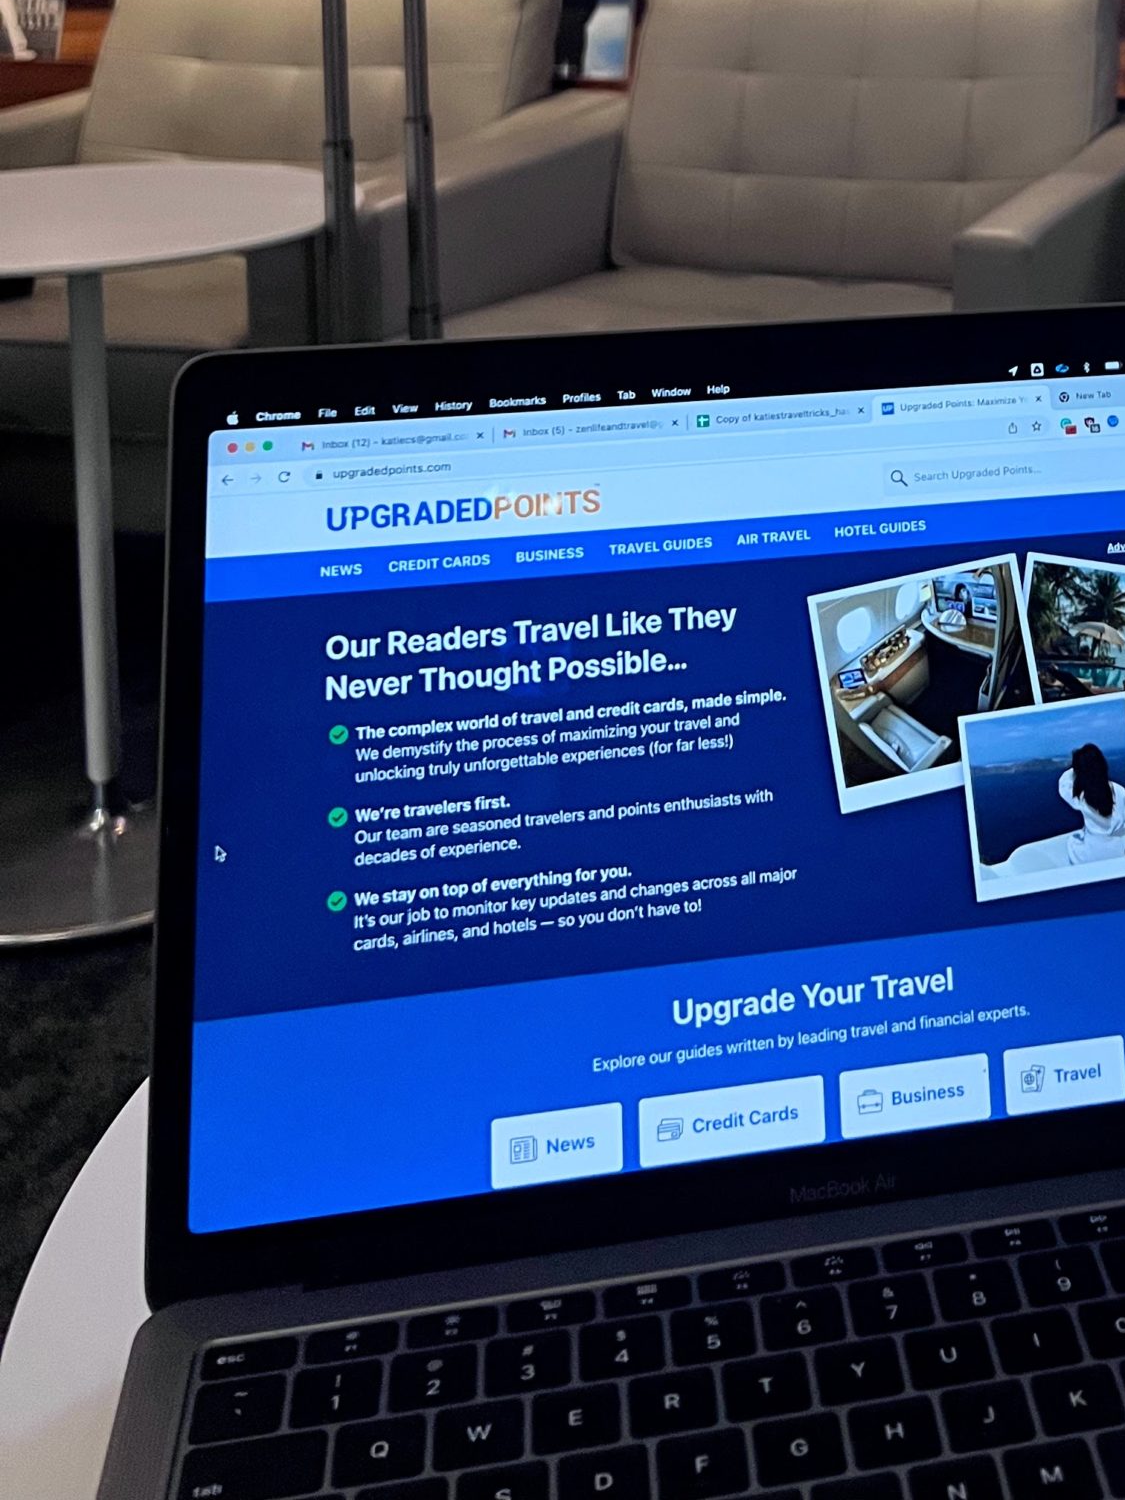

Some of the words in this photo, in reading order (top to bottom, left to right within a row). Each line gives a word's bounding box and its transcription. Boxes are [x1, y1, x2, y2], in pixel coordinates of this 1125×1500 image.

[254, 410, 302, 423] Chrome
[317, 407, 338, 419] File
[353, 404, 376, 417] Edit
[391, 403, 419, 414] View
[434, 400, 473, 412] History
[488, 394, 547, 409] Bookmarks
[561, 391, 602, 404] Profiles
[616, 389, 637, 401] Tab
[650, 386, 692, 398] Window
[705, 383, 731, 395] Help
[331, 462, 452, 481] upgradedpoints.com
[912, 469, 949, 483] Search
[950, 466, 1001, 481] Upgraded
[1001, 464, 1043, 477] Points...
[735, 532, 759, 546] AIR
[760, 528, 812, 544] TRAVEL
[833, 523, 877, 538] HOTEL
[878, 518, 927, 534] GUIDES
[514, 545, 585, 564] BUSINESS
[607, 540, 660, 556] TRAVEL
[661, 535, 713, 552] GUIDES
[319, 562, 363, 578] NEWS
[387, 556, 440, 573] CREDIT
[441, 553, 491, 569] CARDS
[324, 634, 382, 661] Our
[386, 624, 507, 656] Readers
[512, 613, 599, 645] Travel
[605, 609, 663, 638] Like
[667, 605, 738, 633] They
[324, 673, 413, 701] Never
[417, 659, 542, 693] Thought
[547, 647, 688, 682] Possible...
[354, 724, 386, 741] The
[387, 718, 454, 738] complex
[455, 713, 500, 731] world
[500, 710, 519, 728] of
[519, 707, 564, 726] travel
[565, 704, 595, 722] and
[595, 700, 641, 719] credit
[642, 696, 689, 714] cards,
[690, 692, 733, 710] made
[734, 687, 787, 707] simple.
[354, 746, 380, 762] We
[381, 739, 453, 760] demystify
[454, 737, 480, 753] the
[481, 733, 539, 753] process
[540, 728, 557, 745] of
[558, 722, 638, 743] maximizing
[639, 720, 672, 738] your
[673, 714, 712, 732] travel
[713, 711, 741, 729] and
[354, 763, 426, 784] unlocking
[427, 759, 461, 777] truly
[463, 750, 559, 773] unforgettable
[560, 744, 646, 765] experiences
[648, 739, 674, 758] (for
[674, 737, 696, 753] far
[696, 732, 734, 750] less!)
[353, 805, 401, 823] We're
[402, 798, 472, 818] travelers
[473, 794, 511, 811] first.
[353, 828, 383, 845] Our
[384, 826, 423, 842] team
[424, 823, 450, 838] are
[451, 812, 522, 835] seasoned
[523, 808, 586, 828] travelers
[587, 803, 615, 821] and
[617, 800, 661, 821] points
[662, 792, 742, 813] enthusiasts
[743, 787, 774, 805] with
[353, 847, 418, 867] decades
[419, 842, 437, 860] of
[437, 837, 522, 859] experience.
[353, 890, 380, 907] We
[381, 888, 417, 904] stay
[418, 885, 440, 900] on
[441, 882, 469, 899] top
[470, 877, 489, 894] of
[489, 869, 573, 892] everything
[573, 867, 598, 883] for
[598, 865, 633, 883] you.
[353, 913, 377, 929] It's
[378, 911, 405, 927] our
[405, 906, 432, 926] job
[432, 906, 450, 921] to
[451, 898, 509, 918] monitor
[510, 895, 537, 913] key
[538, 890, 598, 910] updates
[599, 883, 627, 902] and
[629, 880, 690, 899] changes
[691, 874, 738, 891] across
[739, 869, 757, 886] all
[758, 866, 798, 884] major
[352, 932, 399, 952] cards,
[401, 927, 459, 946] airlines,
[461, 920, 490, 939] and
[492, 916, 538, 936] hotels
[556, 914, 576, 928] so
[577, 911, 605, 929] you
[606, 904, 645, 923] don't
[646, 902, 681, 918] have
[682, 897, 702, 914] to!
[672, 987, 796, 1029] Upgrade
[800, 981, 866, 1009] Your
[869, 965, 954, 1000] Travel
[592, 1053, 646, 1073] Explore
[648, 1050, 673, 1065] our
[675, 1043, 724, 1065] guides
[725, 1037, 775, 1055] written
[776, 1033, 795, 1050] by
[796, 1027, 848, 1046] leading
[849, 1019, 889, 1039] travel
[890, 1015, 917, 1034] and
[918, 1008, 975, 1030] financial
[976, 1004, 1031, 1023] experts.
[1052, 1061, 1102, 1084] Travel
[890, 1084, 965, 1106] Business
[691, 1111, 745, 1134] Credit
[748, 1104, 799, 1126] Cards
[545, 1135, 596, 1155] News
